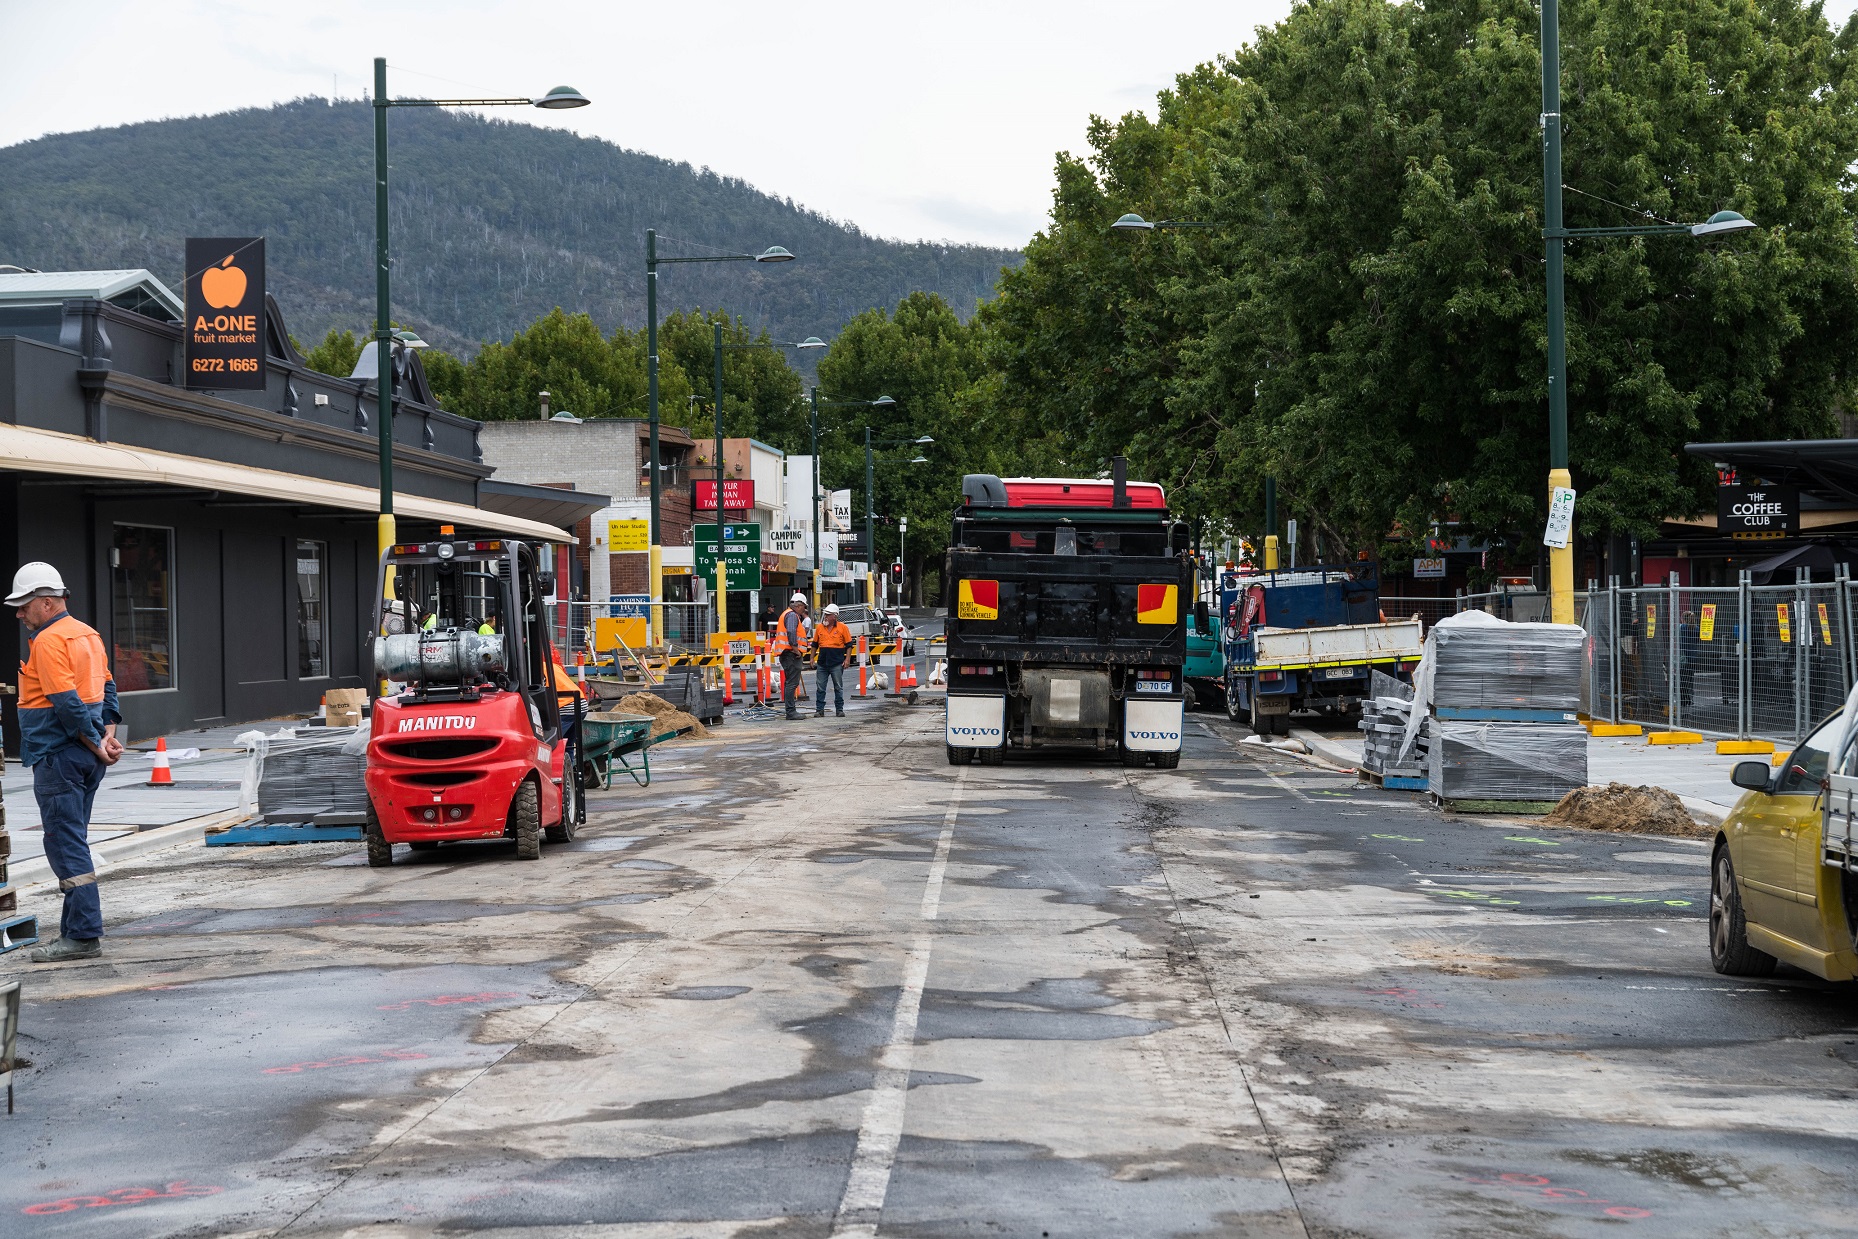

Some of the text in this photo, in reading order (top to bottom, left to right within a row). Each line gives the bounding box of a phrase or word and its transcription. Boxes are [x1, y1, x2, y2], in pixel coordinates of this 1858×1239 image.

[194, 316, 256, 331] A-ONE
[194, 333, 256, 343] fruit market
[192, 358, 258, 372] 6272 1665
[1747, 492, 1766, 502] THE
[834, 507, 849, 515] TAX
[1732, 502, 1782, 514] COFFEE
[1744, 516, 1770, 526] CLUB
[770, 531, 802, 540] CAMPING
[776, 542, 795, 550] HUT
[1418, 560, 1442, 569] APM
[399, 716, 476, 733] MANITOU
[952, 727, 999, 736] VOLVO
[1129, 731, 1178, 740] VOLVO
